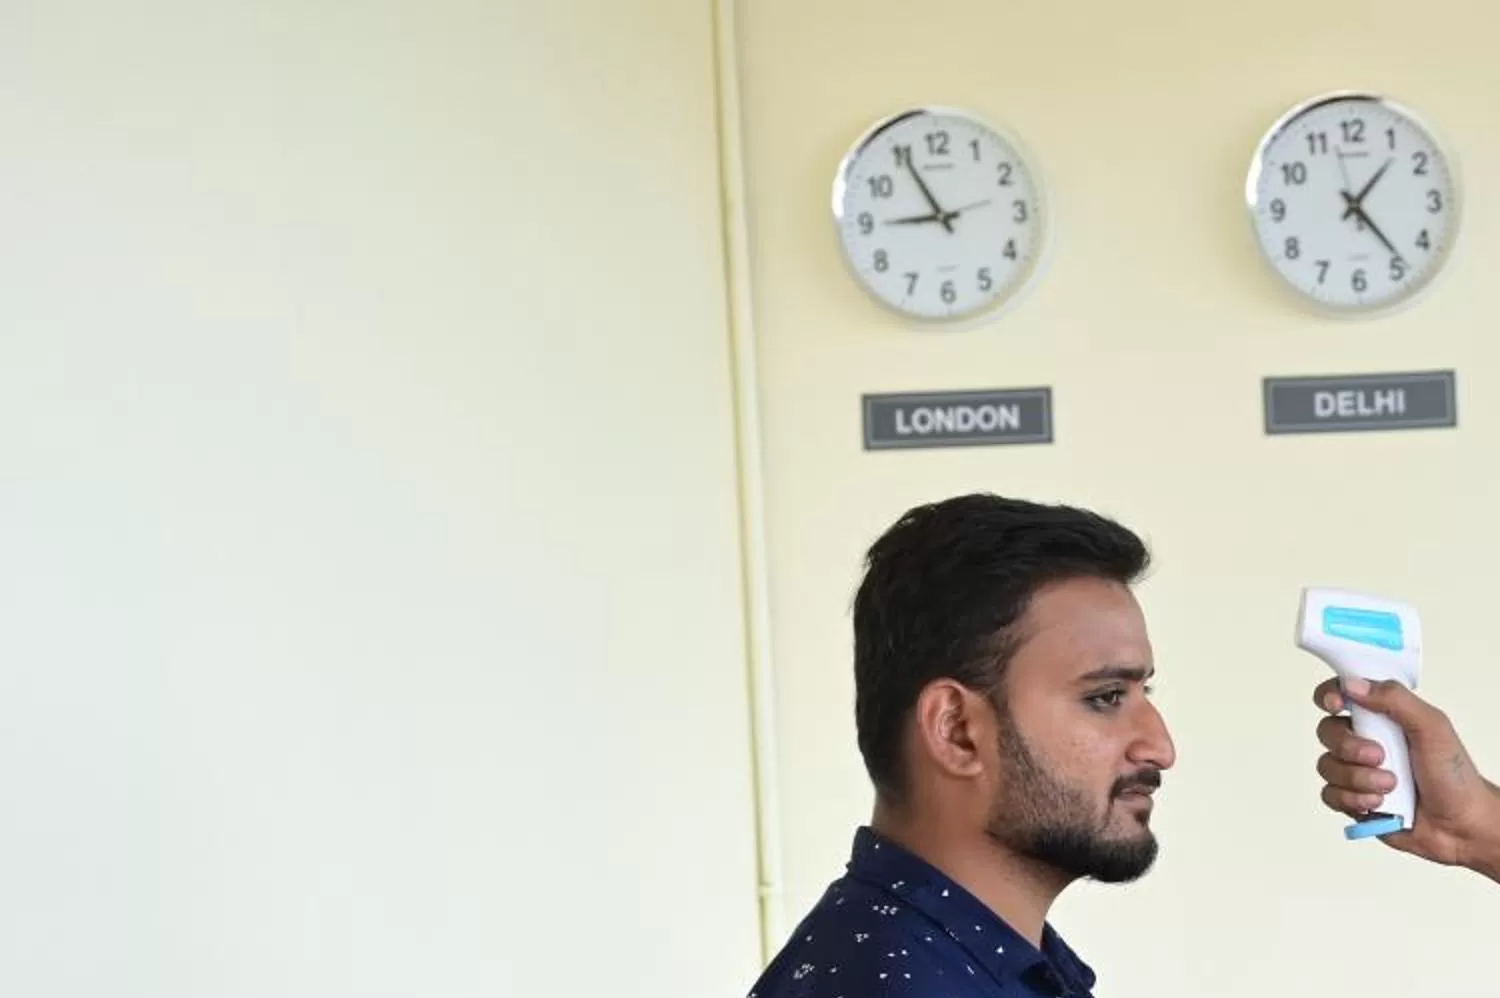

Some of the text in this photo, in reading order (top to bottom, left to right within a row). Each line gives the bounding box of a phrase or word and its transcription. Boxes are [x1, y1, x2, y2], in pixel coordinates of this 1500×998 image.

[924, 130, 950, 156] 12
[1339, 118, 1365, 143] 12
[1384, 127, 1396, 151] 1
[968, 139, 981, 161] 1
[1305, 131, 1328, 156] 11
[997, 161, 1013, 187] 2
[1280, 161, 1308, 186] 10
[1411, 151, 1428, 177] 2
[867, 174, 894, 199] 10
[1012, 199, 1028, 224] 3
[1269, 197, 1287, 223] 9
[1427, 189, 1443, 214] 3
[857, 211, 875, 236] 9
[1002, 239, 1017, 261] 4
[1284, 235, 1301, 261] 8
[1414, 228, 1431, 251] 4
[873, 249, 890, 274] 8
[1315, 259, 1331, 285] 7
[1388, 256, 1405, 282] 5
[903, 271, 920, 296] 7
[939, 279, 957, 304] 6
[976, 267, 993, 292] 5
[1350, 268, 1368, 293] 6
[1313, 388, 1406, 418] DELHI
[895, 403, 1020, 434] LONDON
